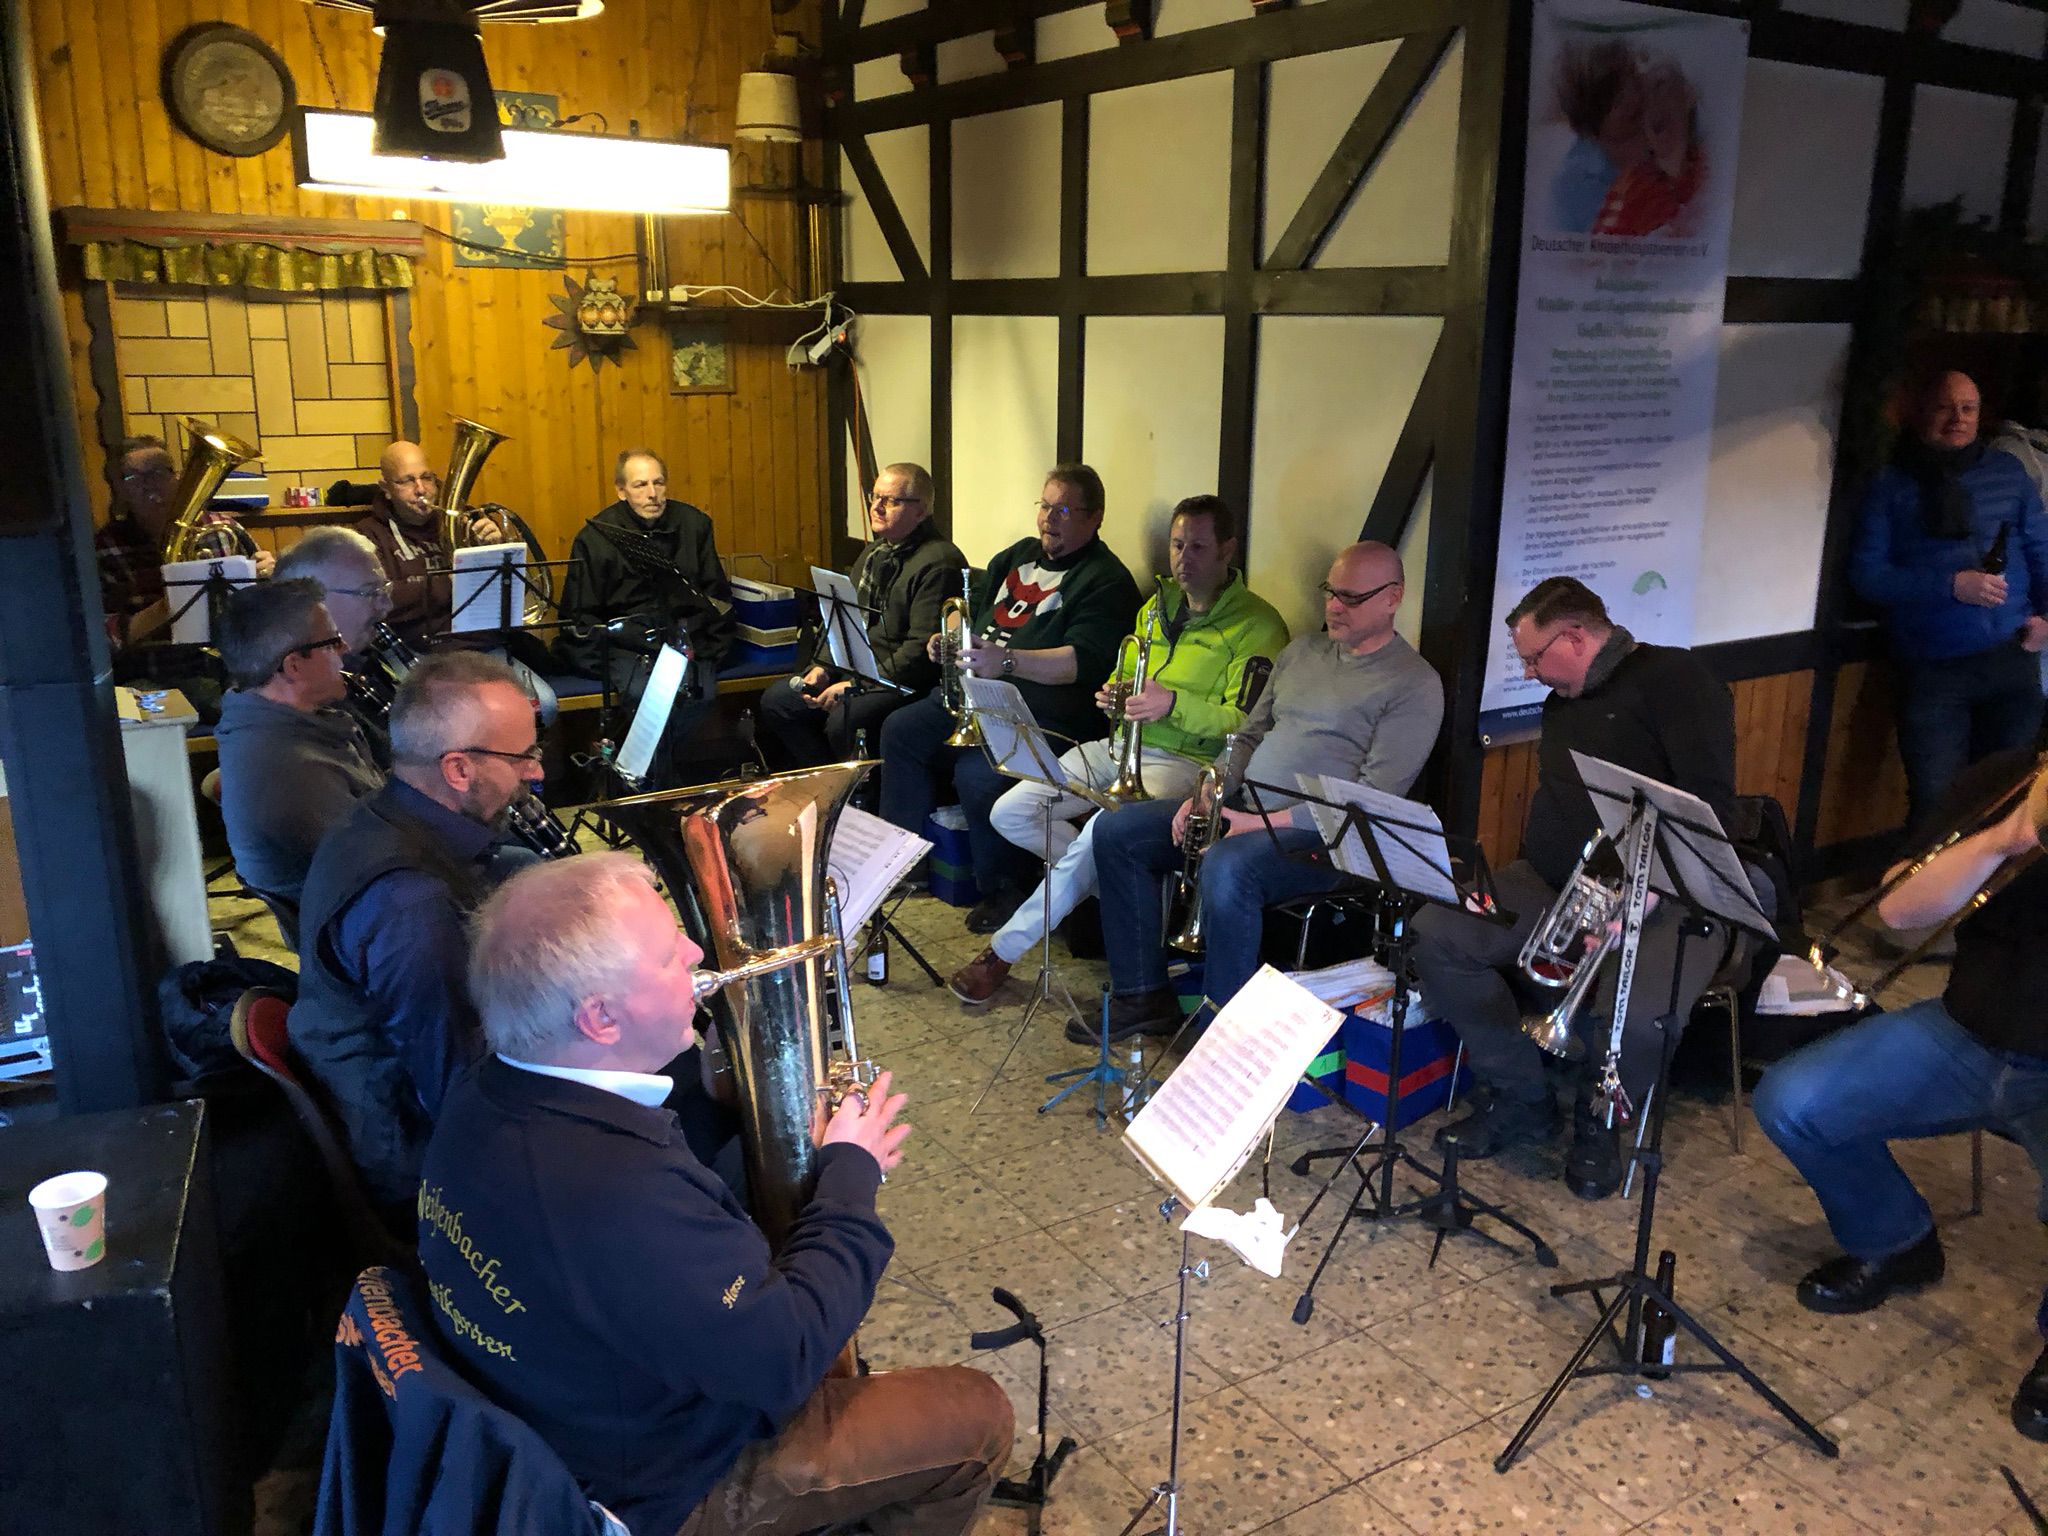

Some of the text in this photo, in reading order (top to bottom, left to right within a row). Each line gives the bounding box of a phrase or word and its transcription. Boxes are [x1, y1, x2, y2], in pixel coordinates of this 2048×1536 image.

[1634, 822, 1652, 908] TOM TAILOR
[1615, 949, 1633, 1033] TOM TAILOR
